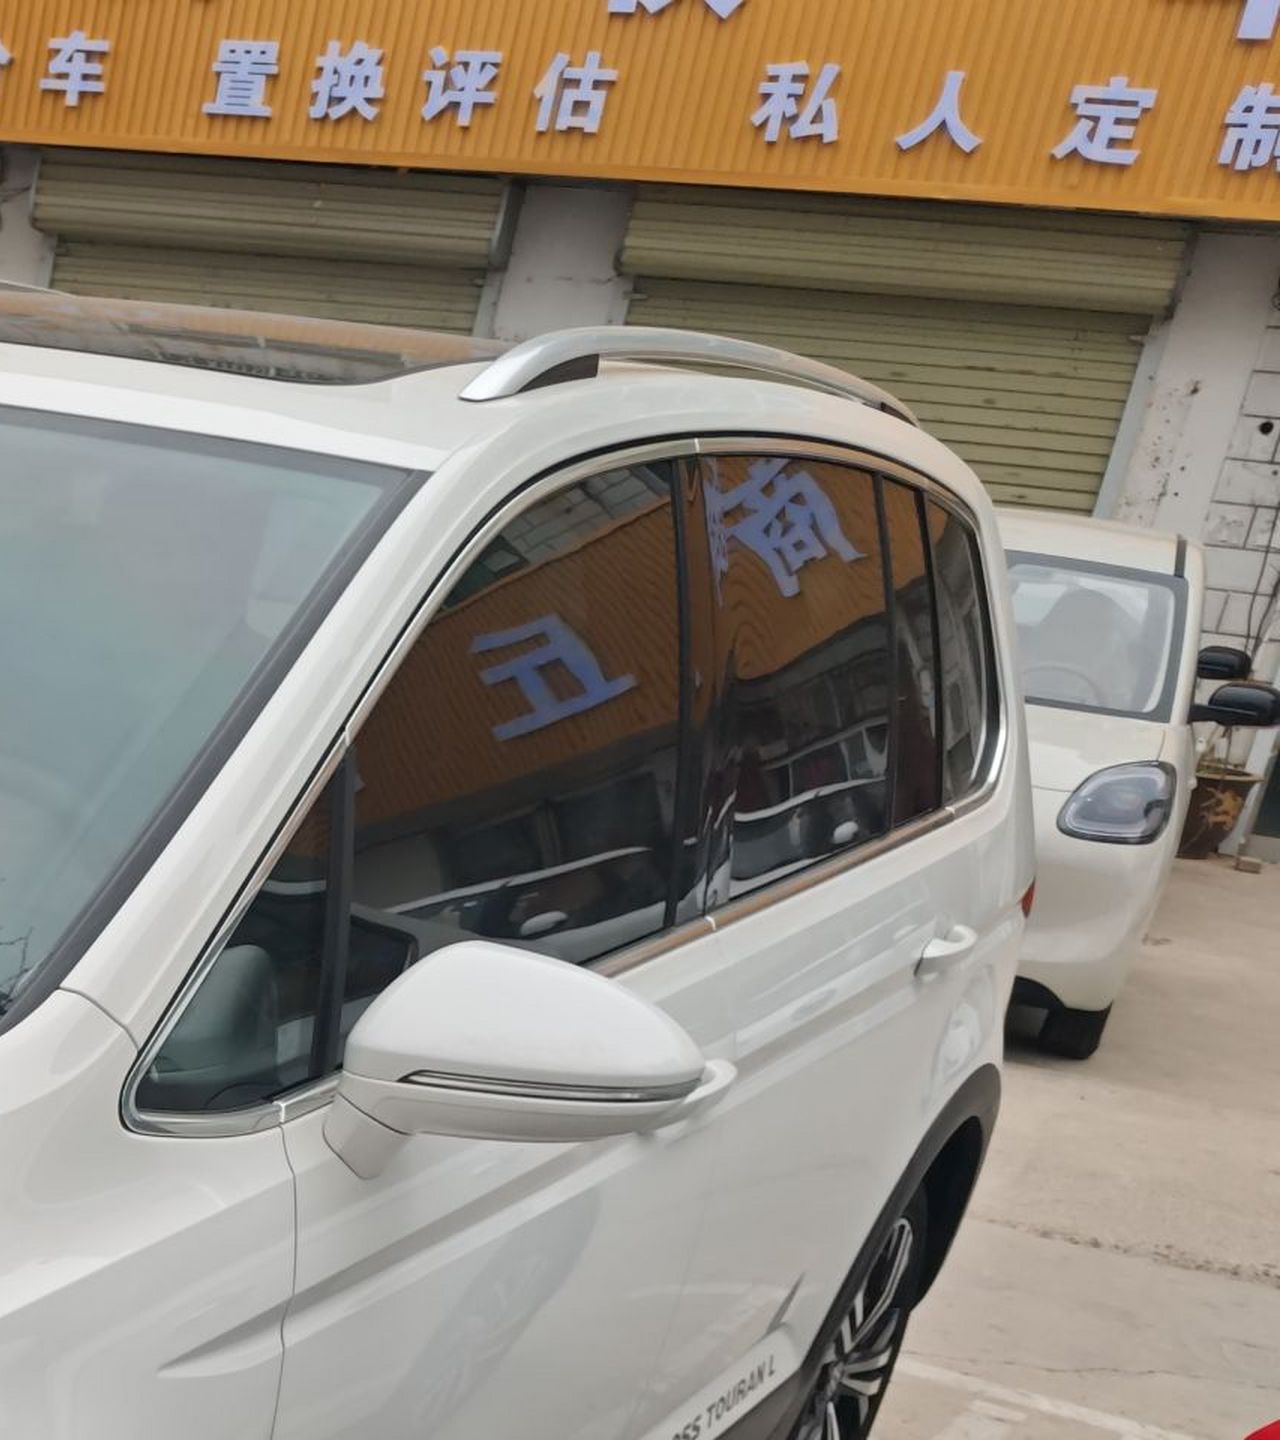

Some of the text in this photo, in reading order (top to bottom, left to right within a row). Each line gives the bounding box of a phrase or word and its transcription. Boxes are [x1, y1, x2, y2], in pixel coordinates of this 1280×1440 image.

[201, 38, 619, 134] 置换评估
[706, 1360, 766, 1429] TOURAN
